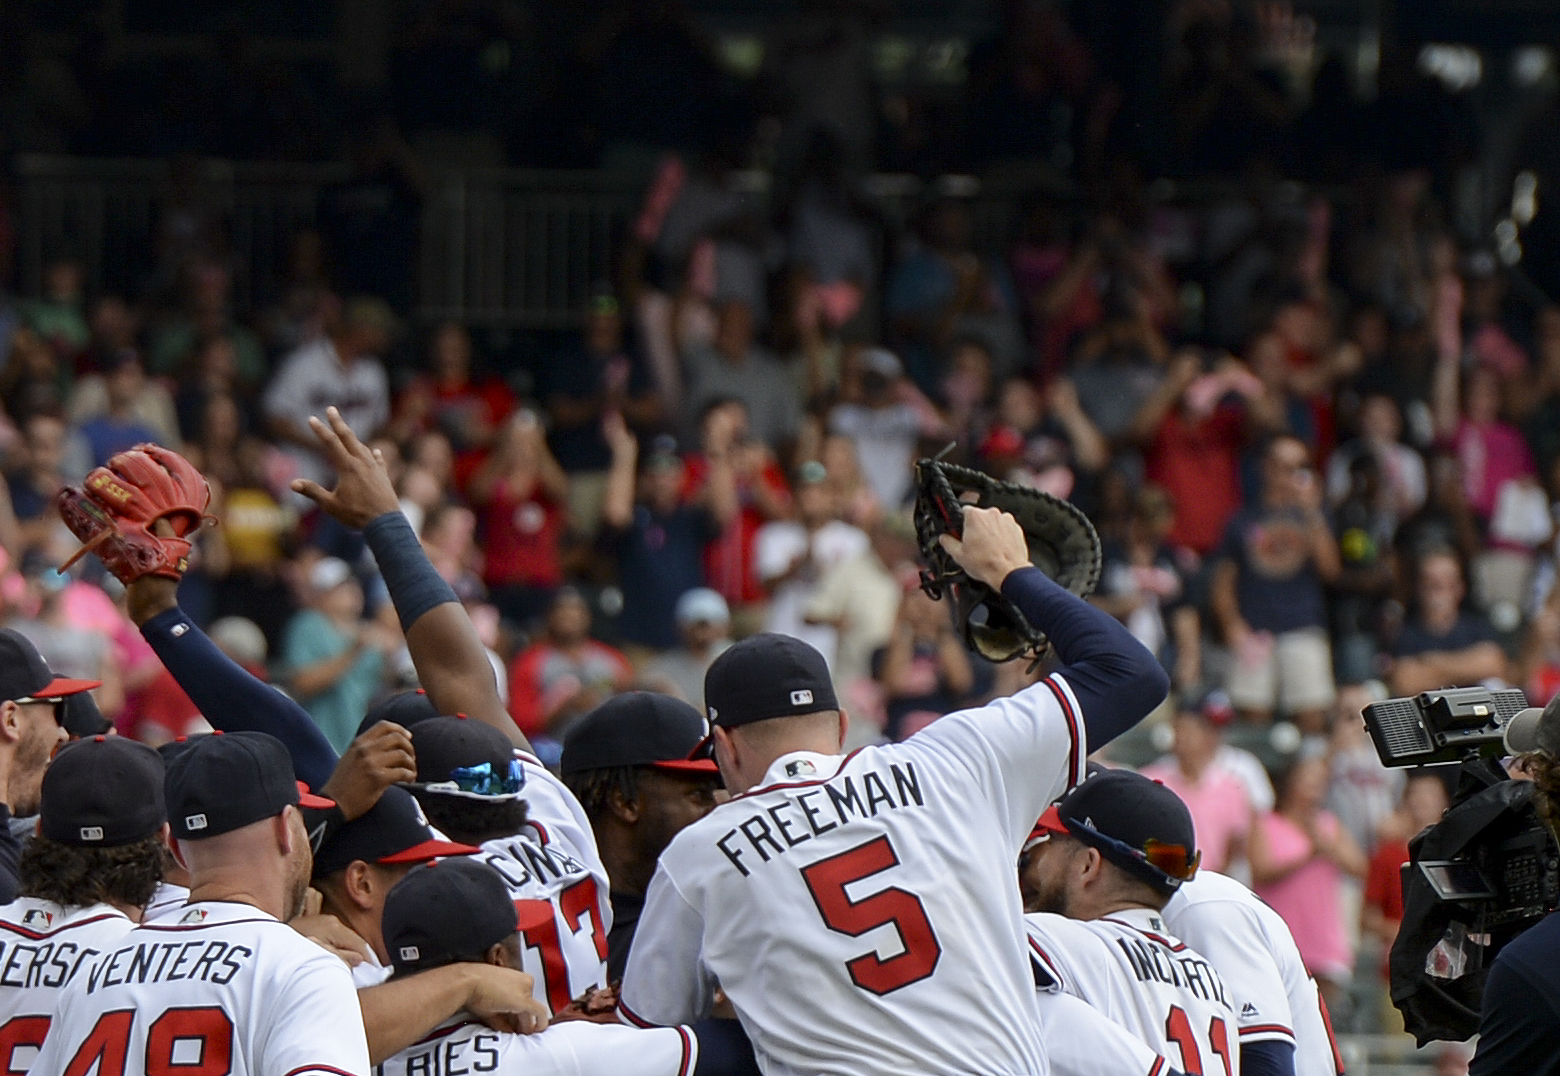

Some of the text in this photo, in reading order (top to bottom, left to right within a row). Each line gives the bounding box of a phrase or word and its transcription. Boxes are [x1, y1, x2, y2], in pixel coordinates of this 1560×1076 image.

[716, 761, 925, 878] FREEMAN
[86, 939, 253, 995] VENTERS
[798, 832, 943, 997] 5
